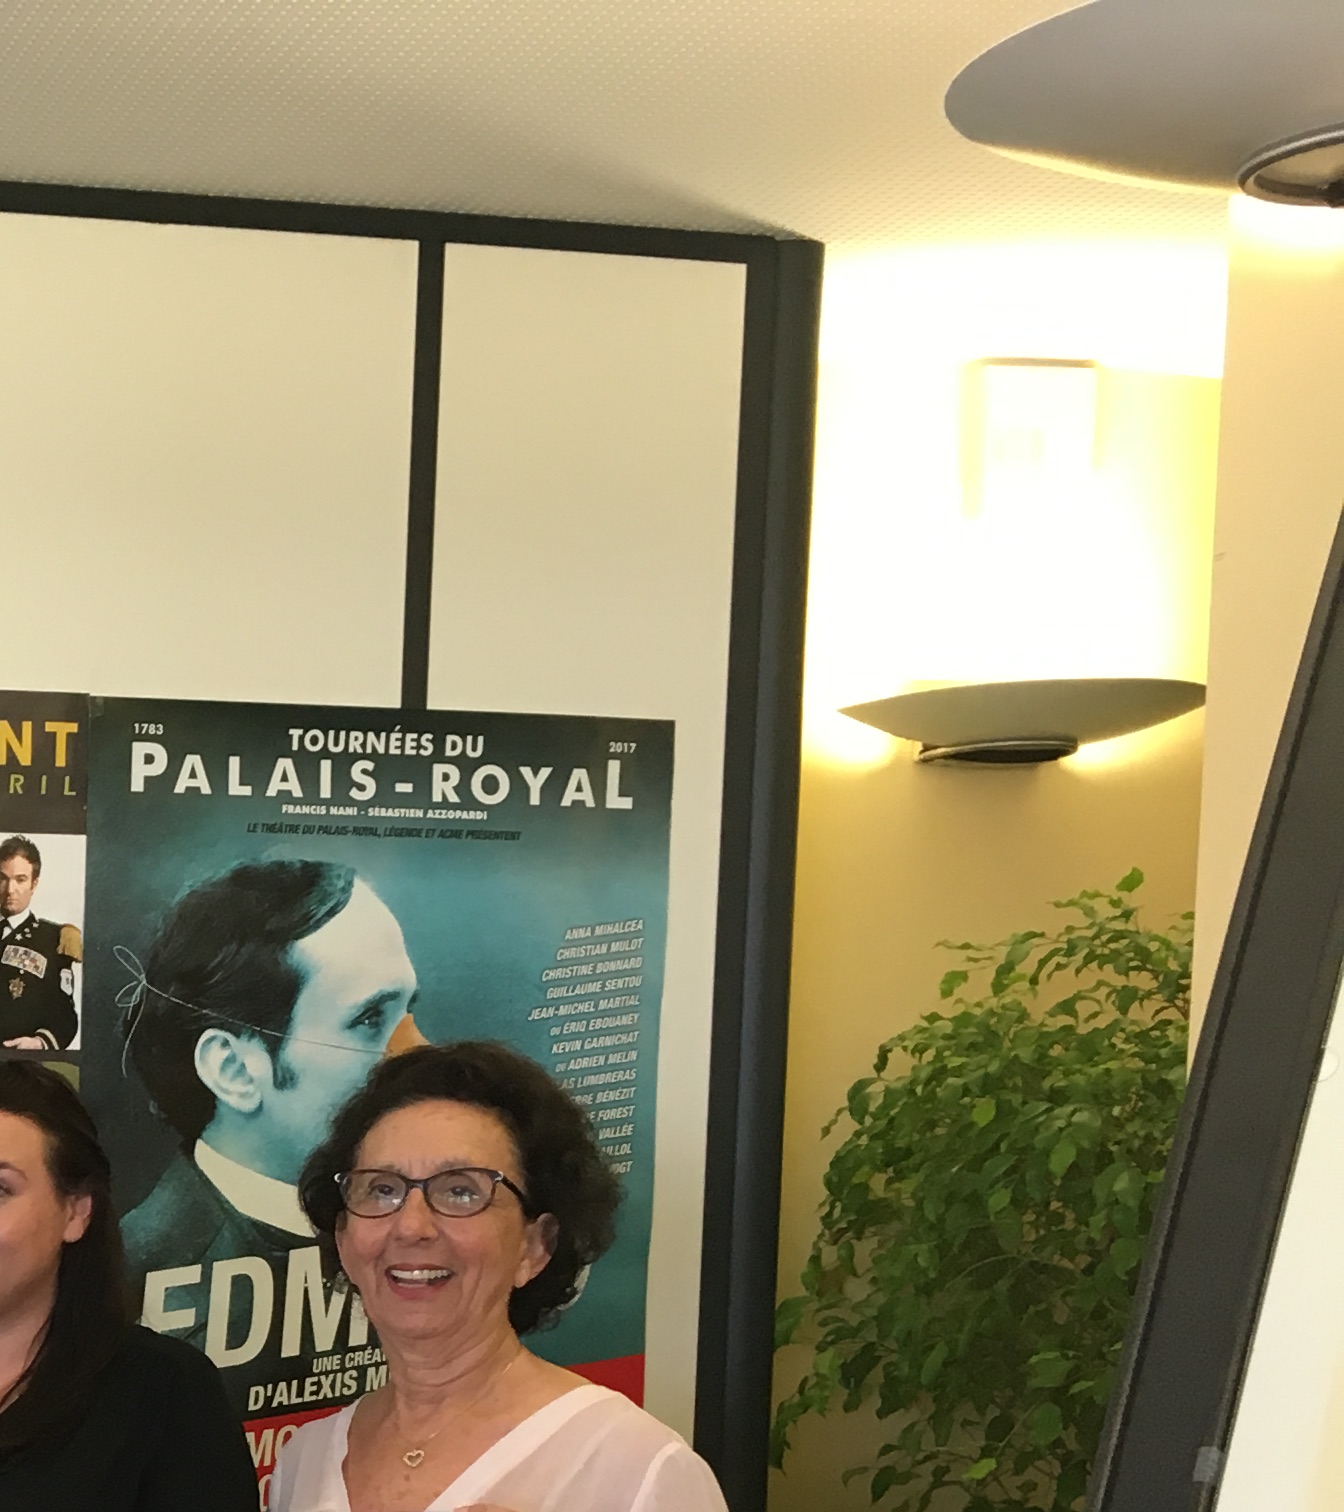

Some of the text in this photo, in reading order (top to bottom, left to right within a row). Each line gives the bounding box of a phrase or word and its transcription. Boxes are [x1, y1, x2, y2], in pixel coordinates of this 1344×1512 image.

[133, 722, 164, 736] 1783
[288, 725, 484, 758] TOURNÉES DU
[608, 741, 637, 755] 2017
[282, 804, 487, 820] FRANCIS NANI SÉBASTIEN AZZOPARDI
[302, 825, 315, 835] DU
[565, 927, 591, 940] ANNA
[557, 938, 644, 960] CHRISTIAN MULOT
[542, 957, 642, 981] CHRISTINE BONNARD
[547, 981, 603, 999] GUILLAUME
[528, 995, 640, 1021] JEAN-MICHEL MARTIAL
[552, 1040, 582, 1054] KEVIN
[568, 1055, 606, 1070] ADRIEN
[598, 1106, 635, 1121] FOREST
[599, 1123, 634, 1139] VALLÉE
[313, 1355, 340, 1373] UNE
[248, 1372, 358, 1412] D'ALEXIS
